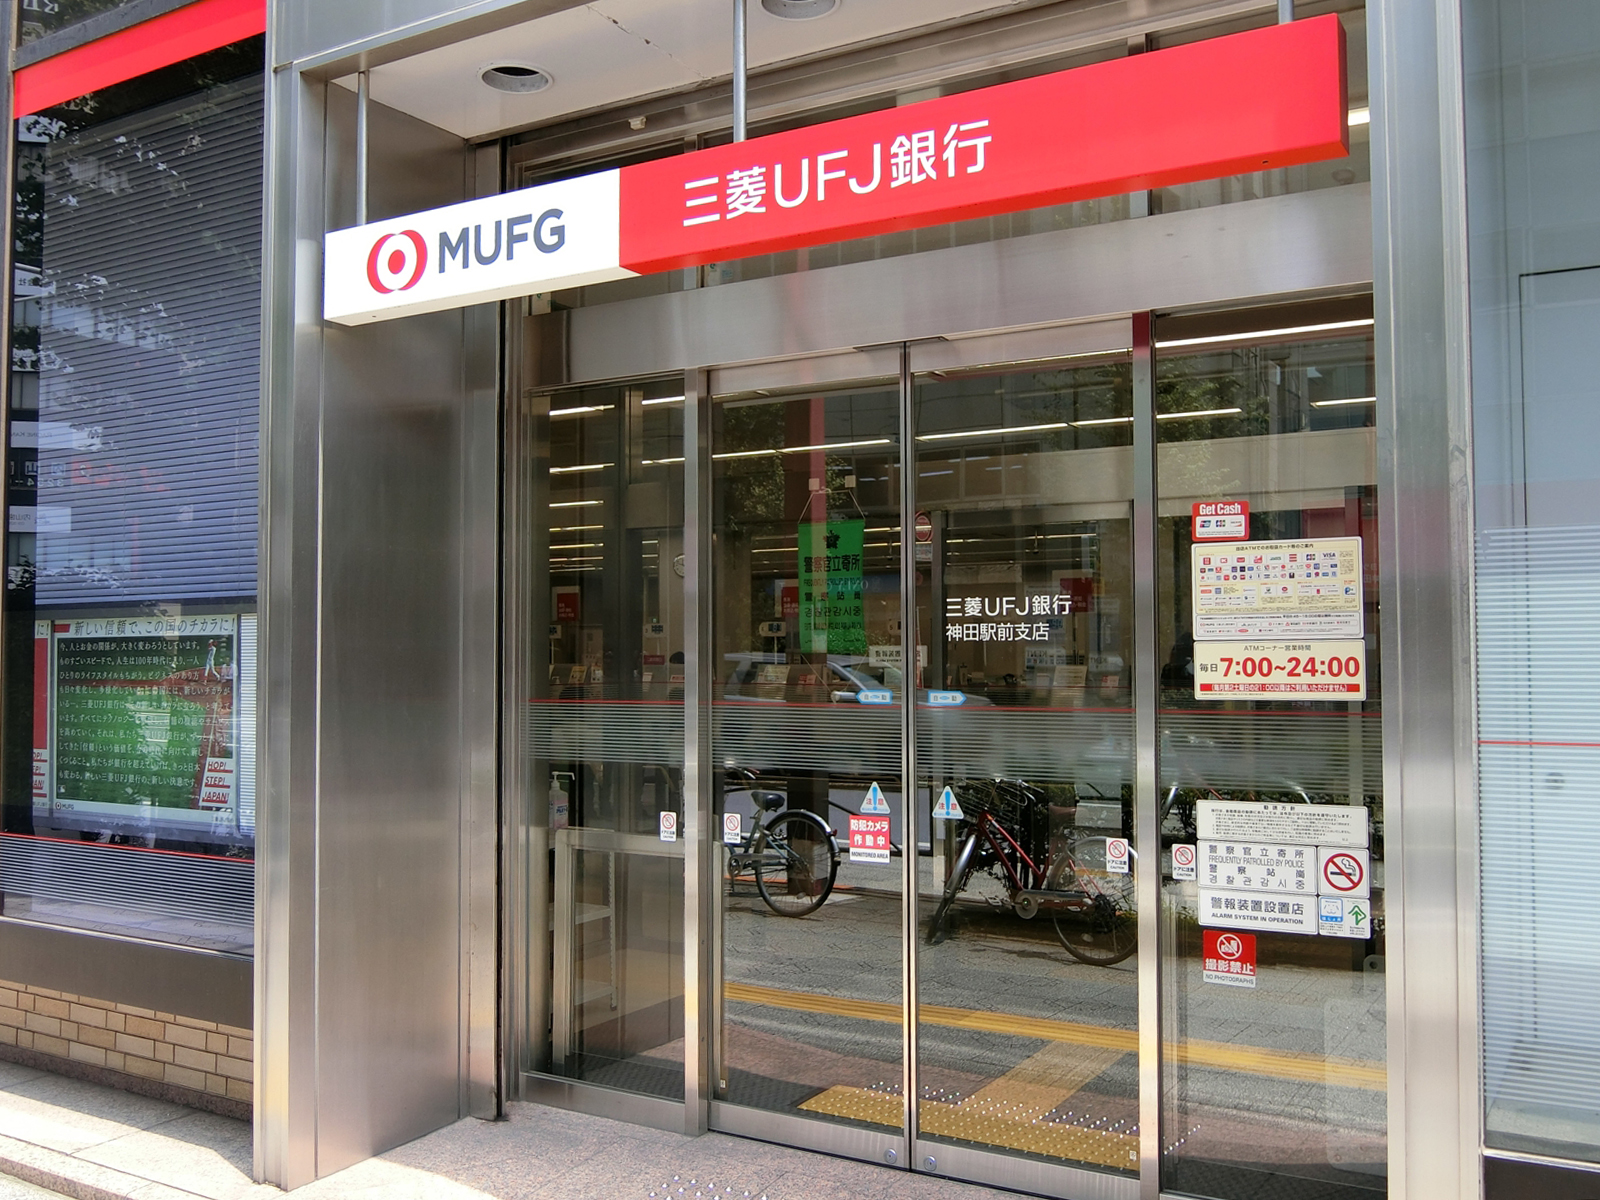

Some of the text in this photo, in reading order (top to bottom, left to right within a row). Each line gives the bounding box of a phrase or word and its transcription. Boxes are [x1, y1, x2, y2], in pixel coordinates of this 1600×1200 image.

[683, 119, 992, 227] 三菱UFJ銀行
[438, 208, 565, 274] MUFG
[1199, 502, 1241, 515] Get Cash
[804, 554, 860, 573] 警察官立寄所
[946, 594, 1072, 617] 三菱UFJ銀行
[946, 622, 1050, 641] 神田駅前支店
[1199, 656, 1361, 678] 毎日 7:00~24:00
[207, 761, 227, 770] HOP!
[205, 776, 226, 785] STEP!
[202, 791, 229, 801] JAPAN!
[938, 802, 957, 810] 注意
[850, 819, 888, 832] 防犯カメラ
[854, 834, 885, 847] 作動中
[1209, 844, 1304, 859] 警察官立寄所
[1209, 855, 1304, 869] FREQUENTLY PATROLLED BY POLICE
[1209, 874, 1305, 890] 경찰관감시중
[1211, 896, 1304, 915] 警報装置設置店
[1268, 916, 1304, 925] OPERATION
[1205, 958, 1254, 975] 撮影禁止
[1214, 975, 1254, 985] PHOTOGRAPHS
